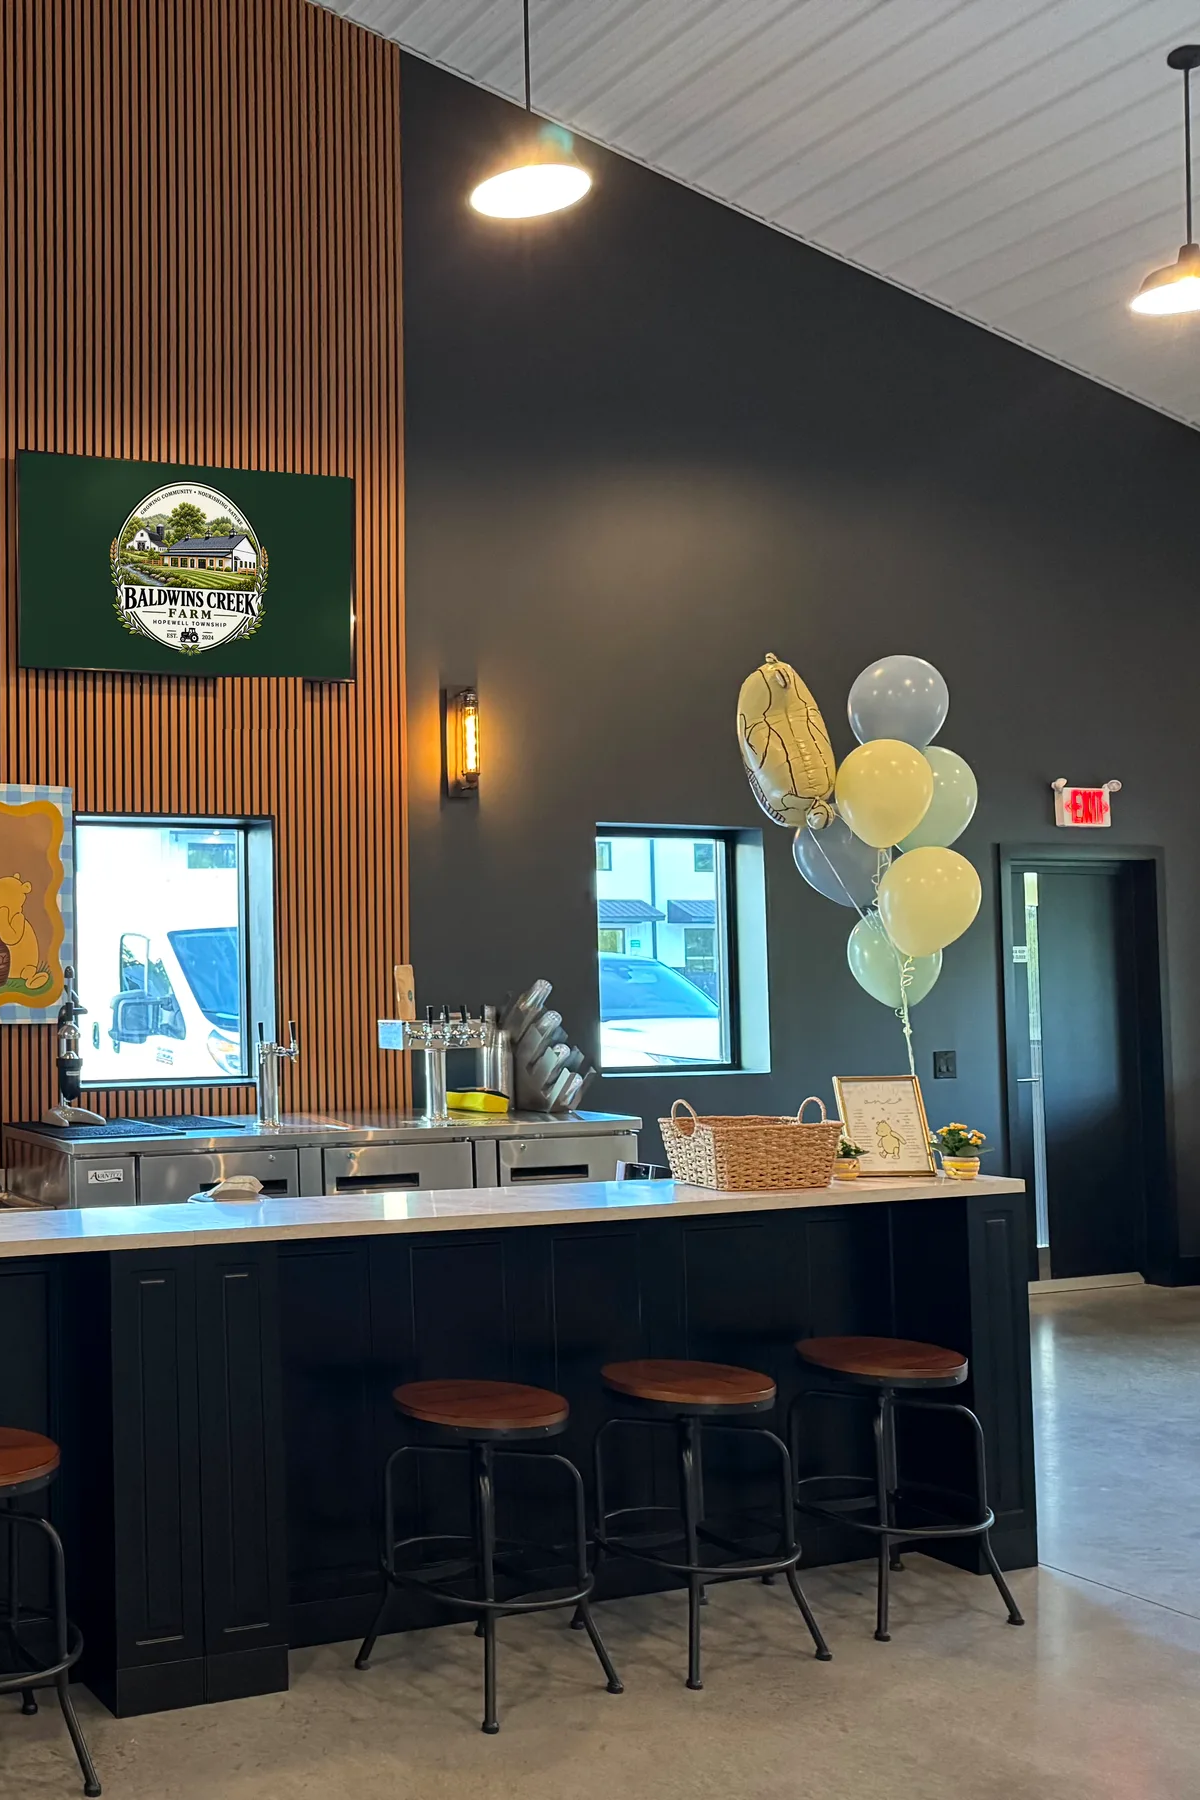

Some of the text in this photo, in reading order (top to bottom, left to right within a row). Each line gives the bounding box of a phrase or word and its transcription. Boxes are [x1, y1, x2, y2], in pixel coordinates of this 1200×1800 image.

[140, 488, 243, 525] GROWING COMMUNITY NOURISHING NATURE
[124, 586, 257, 617] BALDWINS CREEK
[168, 608, 212, 620] FARM
[152, 619, 189, 627] HOPEWELL
[1070, 789, 1105, 824] EXIT
